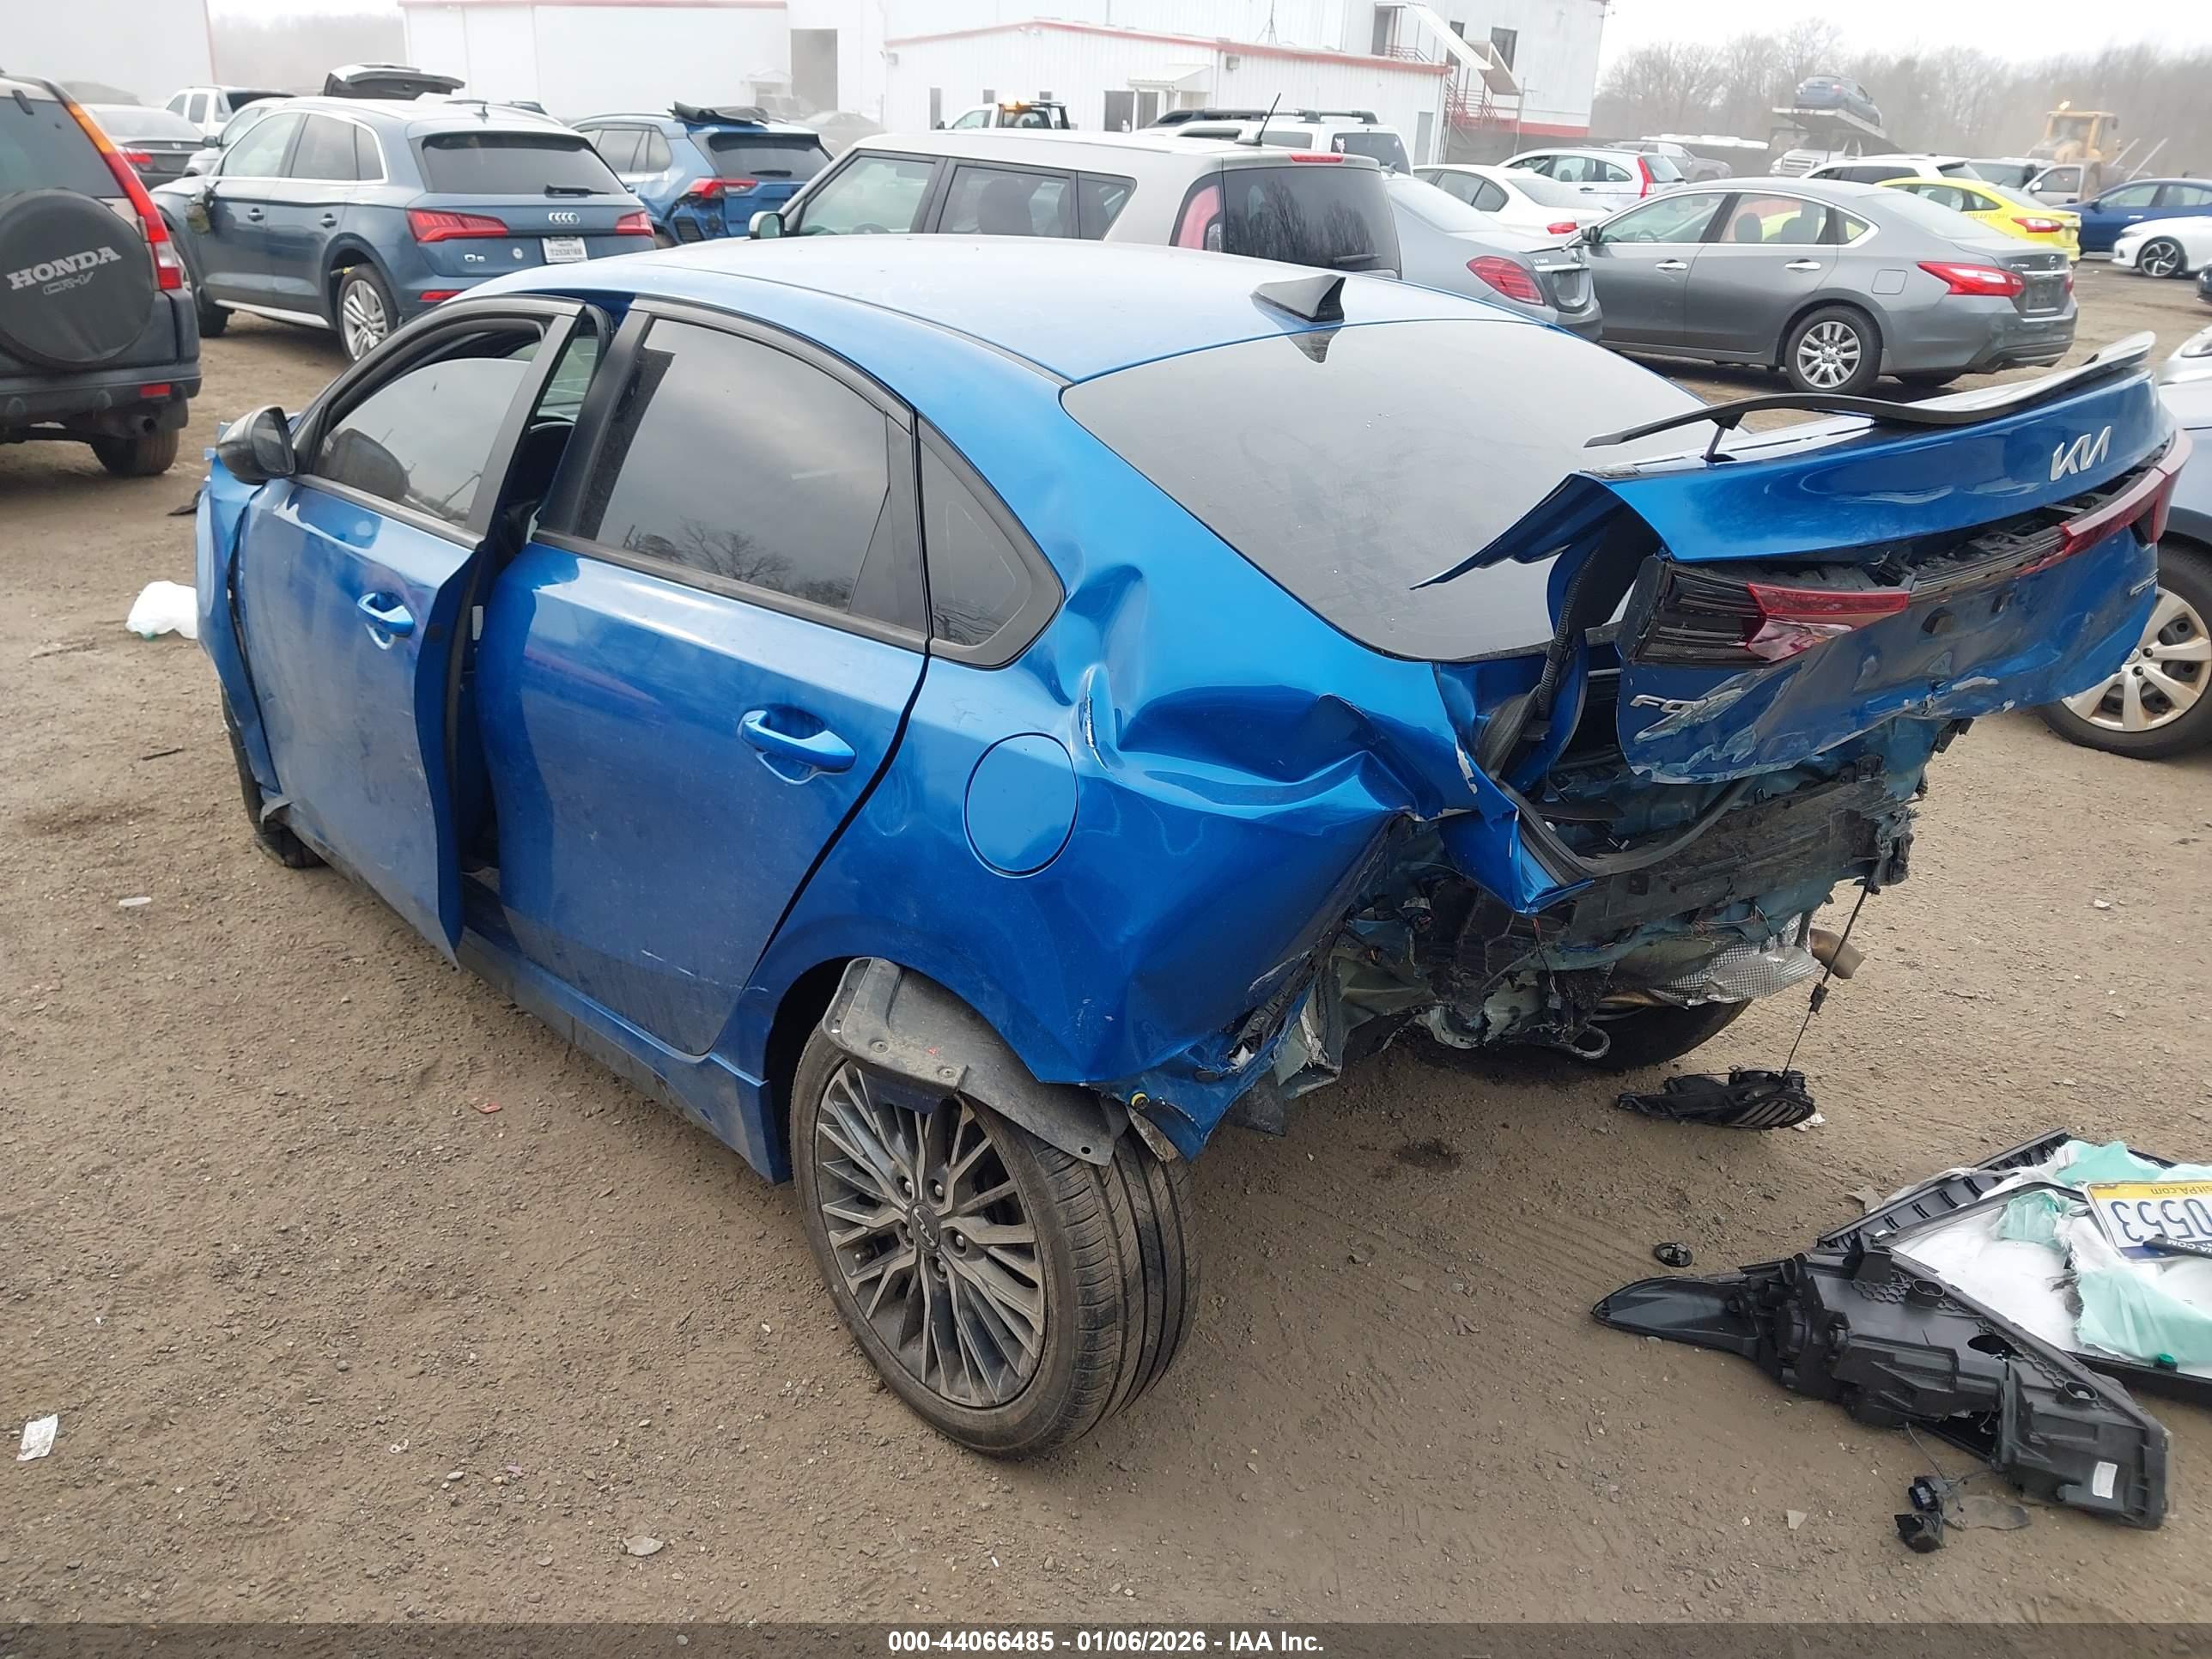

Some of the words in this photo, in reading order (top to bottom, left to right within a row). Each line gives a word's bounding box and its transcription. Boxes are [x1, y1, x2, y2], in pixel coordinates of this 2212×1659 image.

[7, 246, 121, 290] HONDA
[42, 271, 94, 295] CR-V
[2050, 425, 2112, 482] KIA
